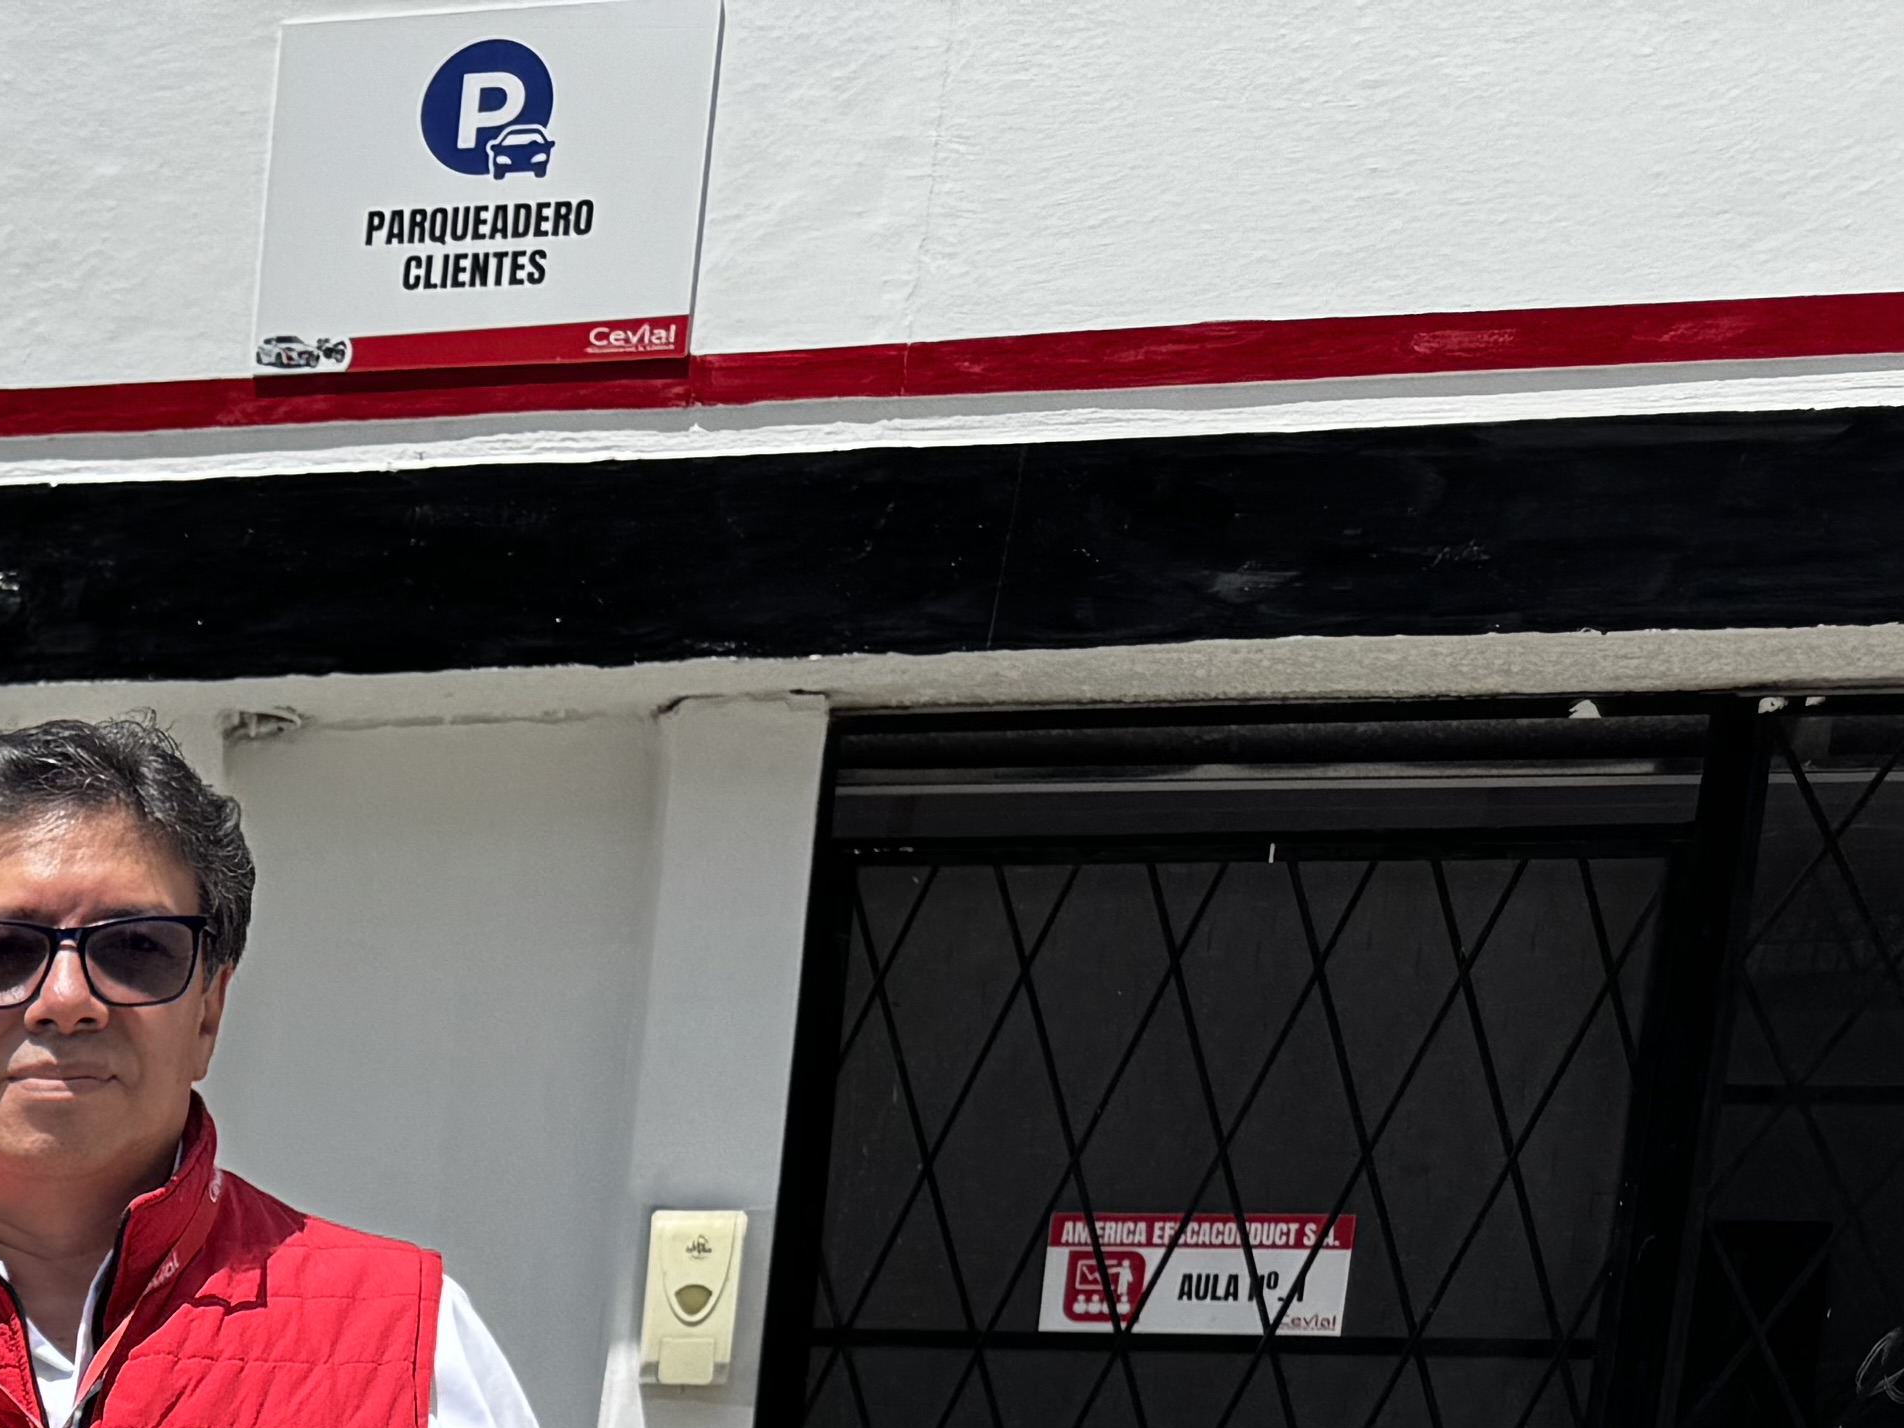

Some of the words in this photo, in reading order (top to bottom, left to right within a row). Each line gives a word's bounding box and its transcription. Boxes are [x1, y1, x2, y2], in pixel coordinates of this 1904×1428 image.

[456, 71, 527, 150] P
[364, 199, 594, 246] PARQUEADERO
[402, 249, 547, 291] CLIENTES
[1061, 1220, 1147, 1246] AMERICA
[1152, 1221, 1298, 1247] EFCACODUCT
[1177, 1273, 1240, 1302] AULA
[1282, 1313, 1337, 1329] evial
